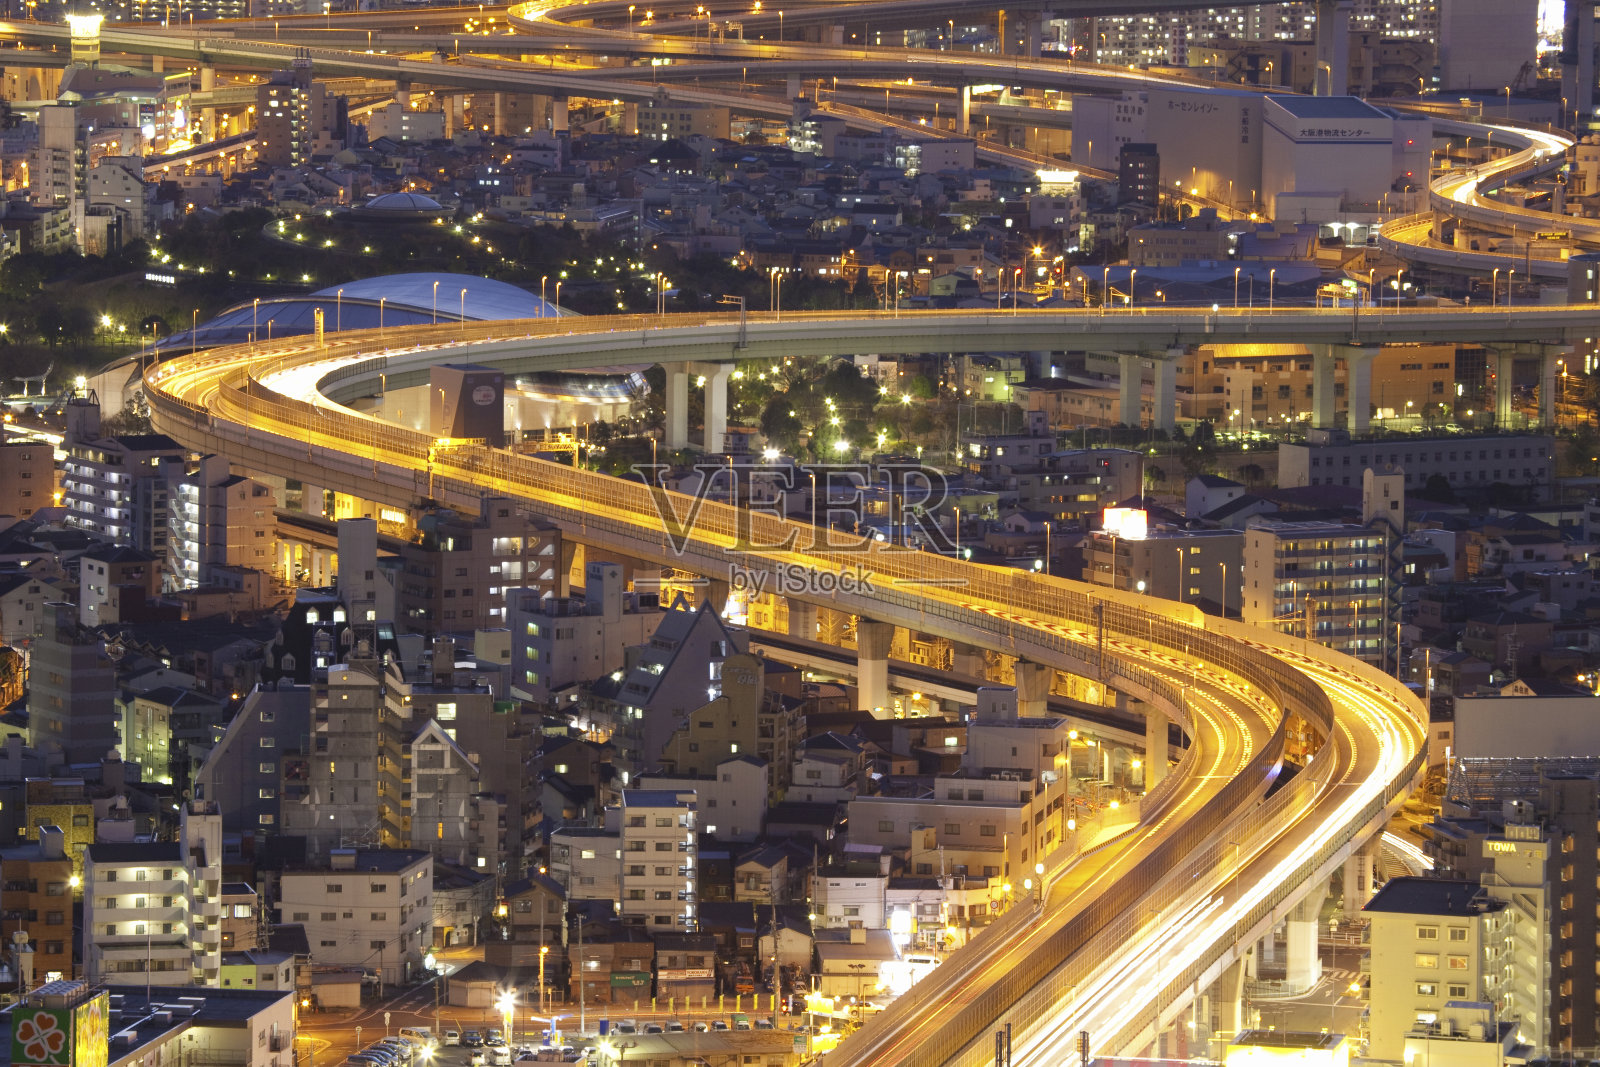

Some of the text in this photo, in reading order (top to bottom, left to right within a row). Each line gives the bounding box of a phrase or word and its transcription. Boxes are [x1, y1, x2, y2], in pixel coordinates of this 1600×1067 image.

[1299, 128, 1371, 137] 大阪港物流センター
[1487, 842, 1517, 852] TOWA
